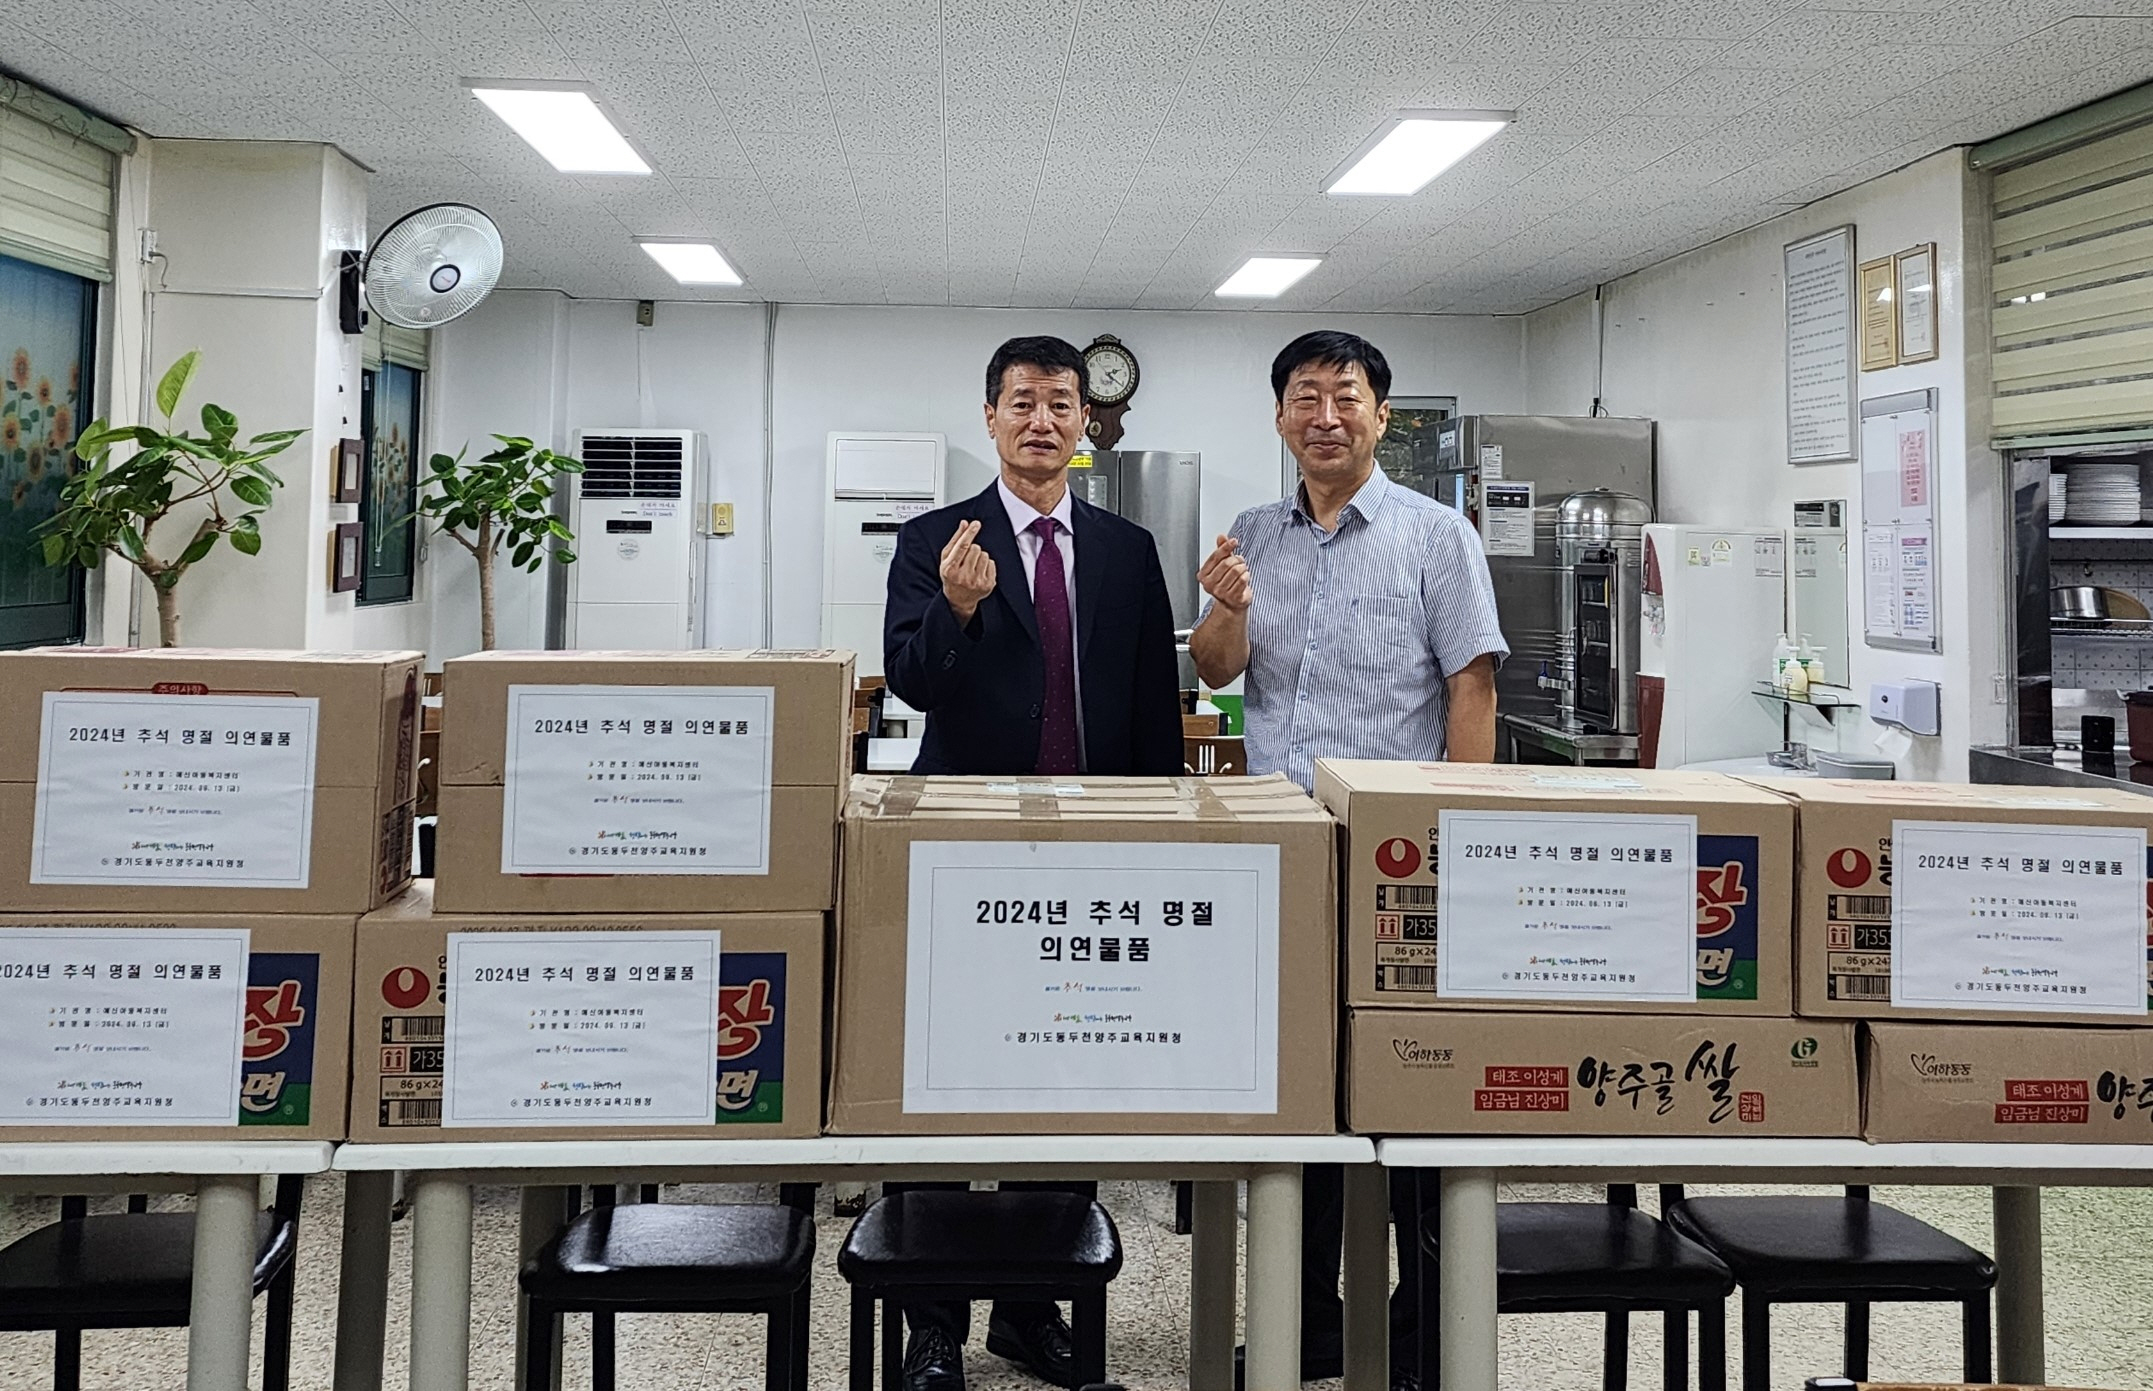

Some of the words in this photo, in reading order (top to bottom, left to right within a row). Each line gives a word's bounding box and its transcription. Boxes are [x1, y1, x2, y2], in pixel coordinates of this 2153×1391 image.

[158, 684, 202, 694] 주의사항
[535, 719, 588, 733] 2024년
[600, 720, 631, 734] 추석
[643, 720, 673, 734] 명절
[685, 720, 749, 735] 의연물품
[69, 728, 125, 742] 2024년
[138, 729, 169, 743] 추석
[182, 730, 213, 745] 명절
[225, 730, 291, 746] 의연물품
[1465, 844, 1517, 859] 2024년
[1529, 846, 1558, 860] 추석
[1570, 847, 1599, 861] 명절
[1611, 848, 1673, 863] 의연물품
[1918, 855, 1969, 870] 2024년
[1980, 857, 2010, 871] 추석
[2021, 858, 2050, 873] 명절
[2062, 860, 2123, 875] 의연물품
[976, 900, 1068, 924] 2024년
[1089, 900, 1141, 925] 추석
[1163, 901, 1214, 926] 명절
[1406, 918, 1436, 937] 가35
[1040, 936, 1150, 962] 의연물품
[1394, 947, 1407, 955] 86
[1846, 956, 1858, 964] 86
[63, 964, 96, 979] 추석
[109, 964, 141, 979] 명절
[153, 964, 222, 979] 의연물품
[475, 967, 530, 982] 2024년
[542, 966, 573, 982] 추석
[586, 966, 617, 982] 명절
[628, 966, 694, 981] 의연물품
[1017, 1032, 1182, 1044] 경기도동두천양주교육지원청
[400, 1080, 412, 1089] 86
[1493, 1070, 1520, 1085] 태조
[1524, 1070, 1562, 1085] 이성계
[1576, 1056, 1675, 1116] 양주골
[1685, 1040, 1740, 1124] 쌀
[2013, 1084, 2041, 1100] 태조
[2044, 1084, 2084, 1100] 이성계
[1480, 1093, 1520, 1108] 임금님
[1525, 1092, 1564, 1109] 진상미
[2001, 1107, 2041, 1122] 임금님
[2046, 1107, 2084, 1122] 진상미
